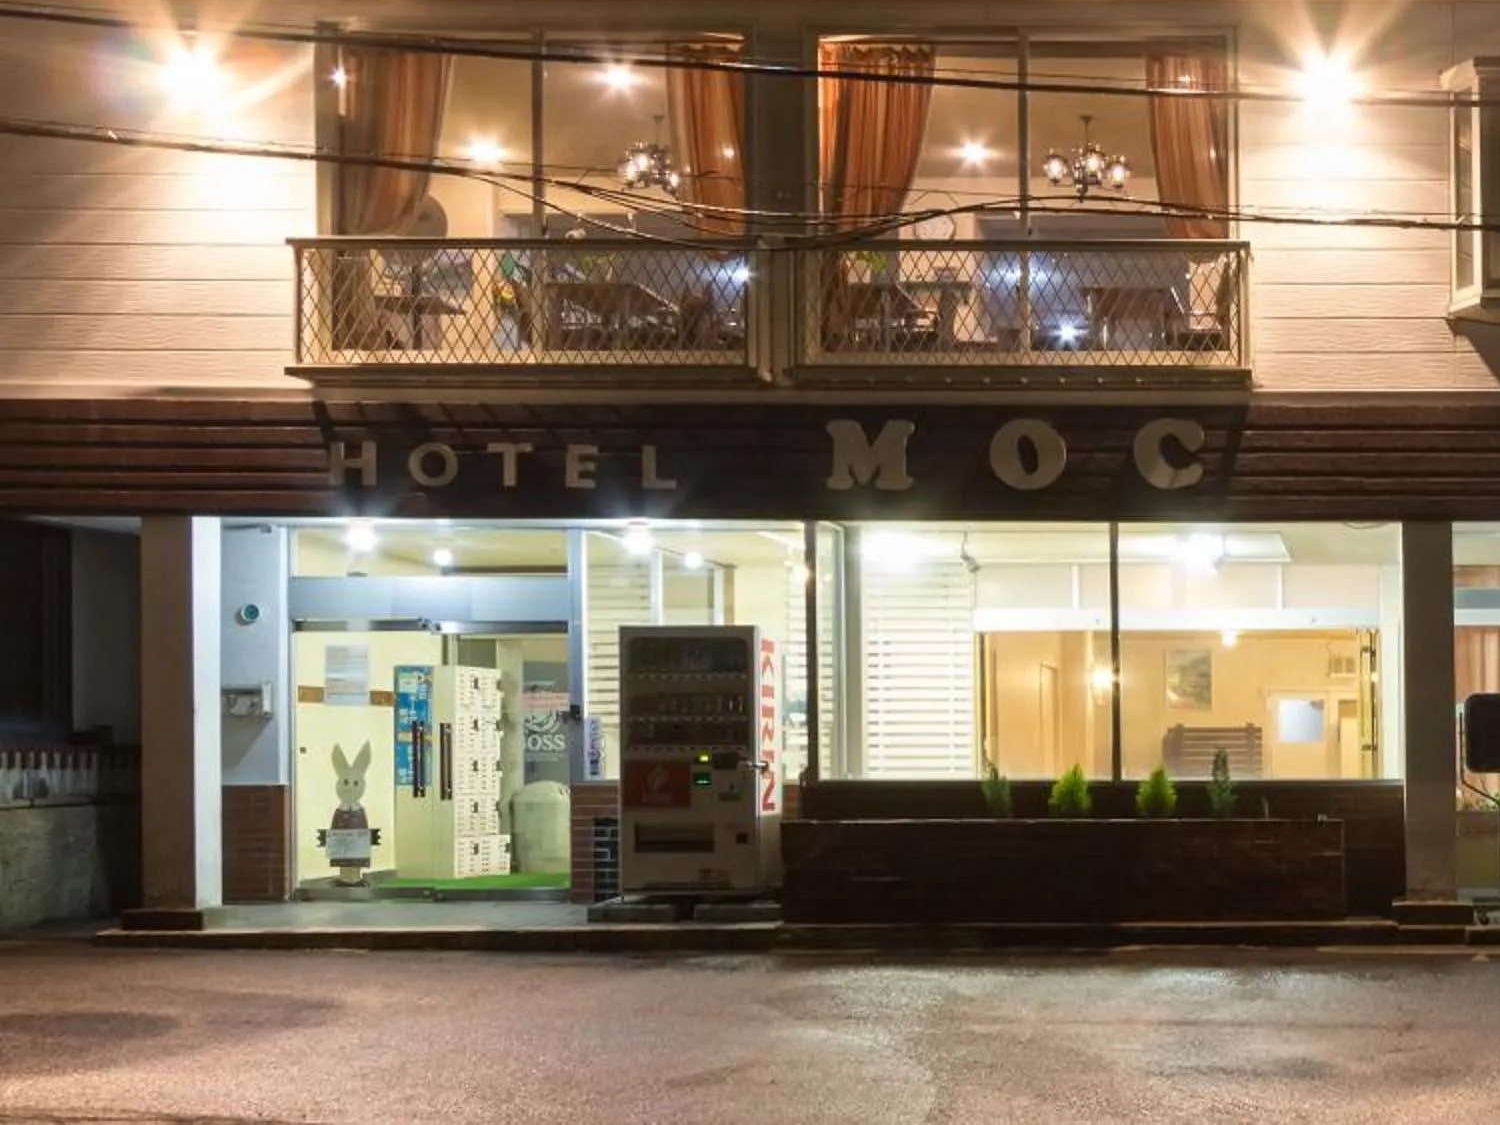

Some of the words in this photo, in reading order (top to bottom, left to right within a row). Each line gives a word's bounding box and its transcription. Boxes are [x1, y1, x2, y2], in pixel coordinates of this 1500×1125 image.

[328, 440, 677, 490] HOTEL
[825, 417, 1205, 491] MOC
[523, 734, 566, 752] OSS
[761, 638, 776, 812] KIRIN
